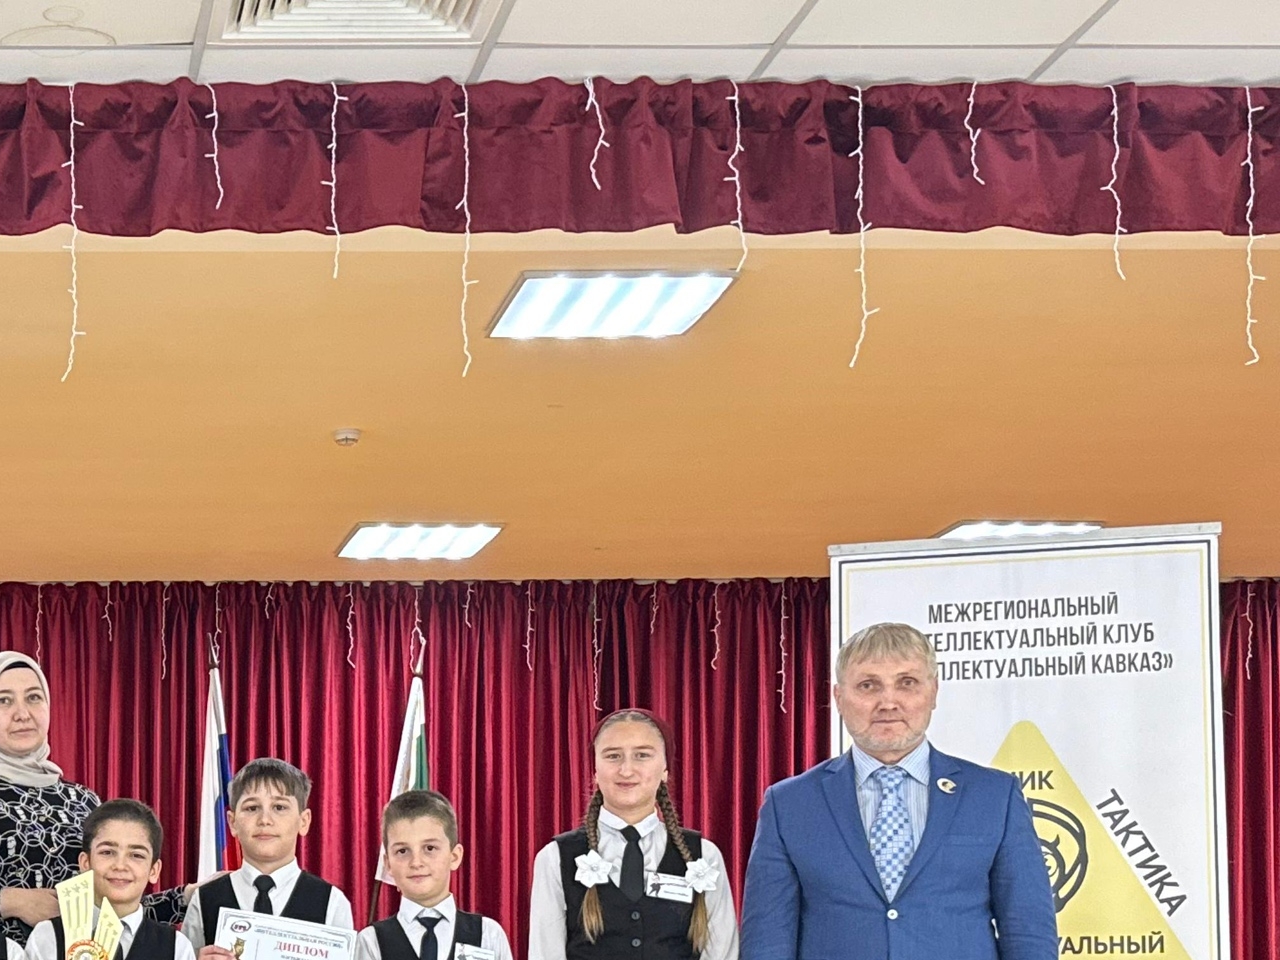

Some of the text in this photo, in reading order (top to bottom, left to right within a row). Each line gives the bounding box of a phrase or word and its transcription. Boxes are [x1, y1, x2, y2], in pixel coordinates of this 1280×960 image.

[928, 592, 1119, 624] МЕЖРЕГИОНАЛЬНЫЙ
[1102, 622, 1154, 644] КЛУБ
[1091, 651, 1174, 675] КАВКАЗ»
[1011, 770, 1054, 790] ИК
[1096, 788, 1187, 917] ТАКТИКА
[273, 940, 329, 959] ДИПЛОМ
